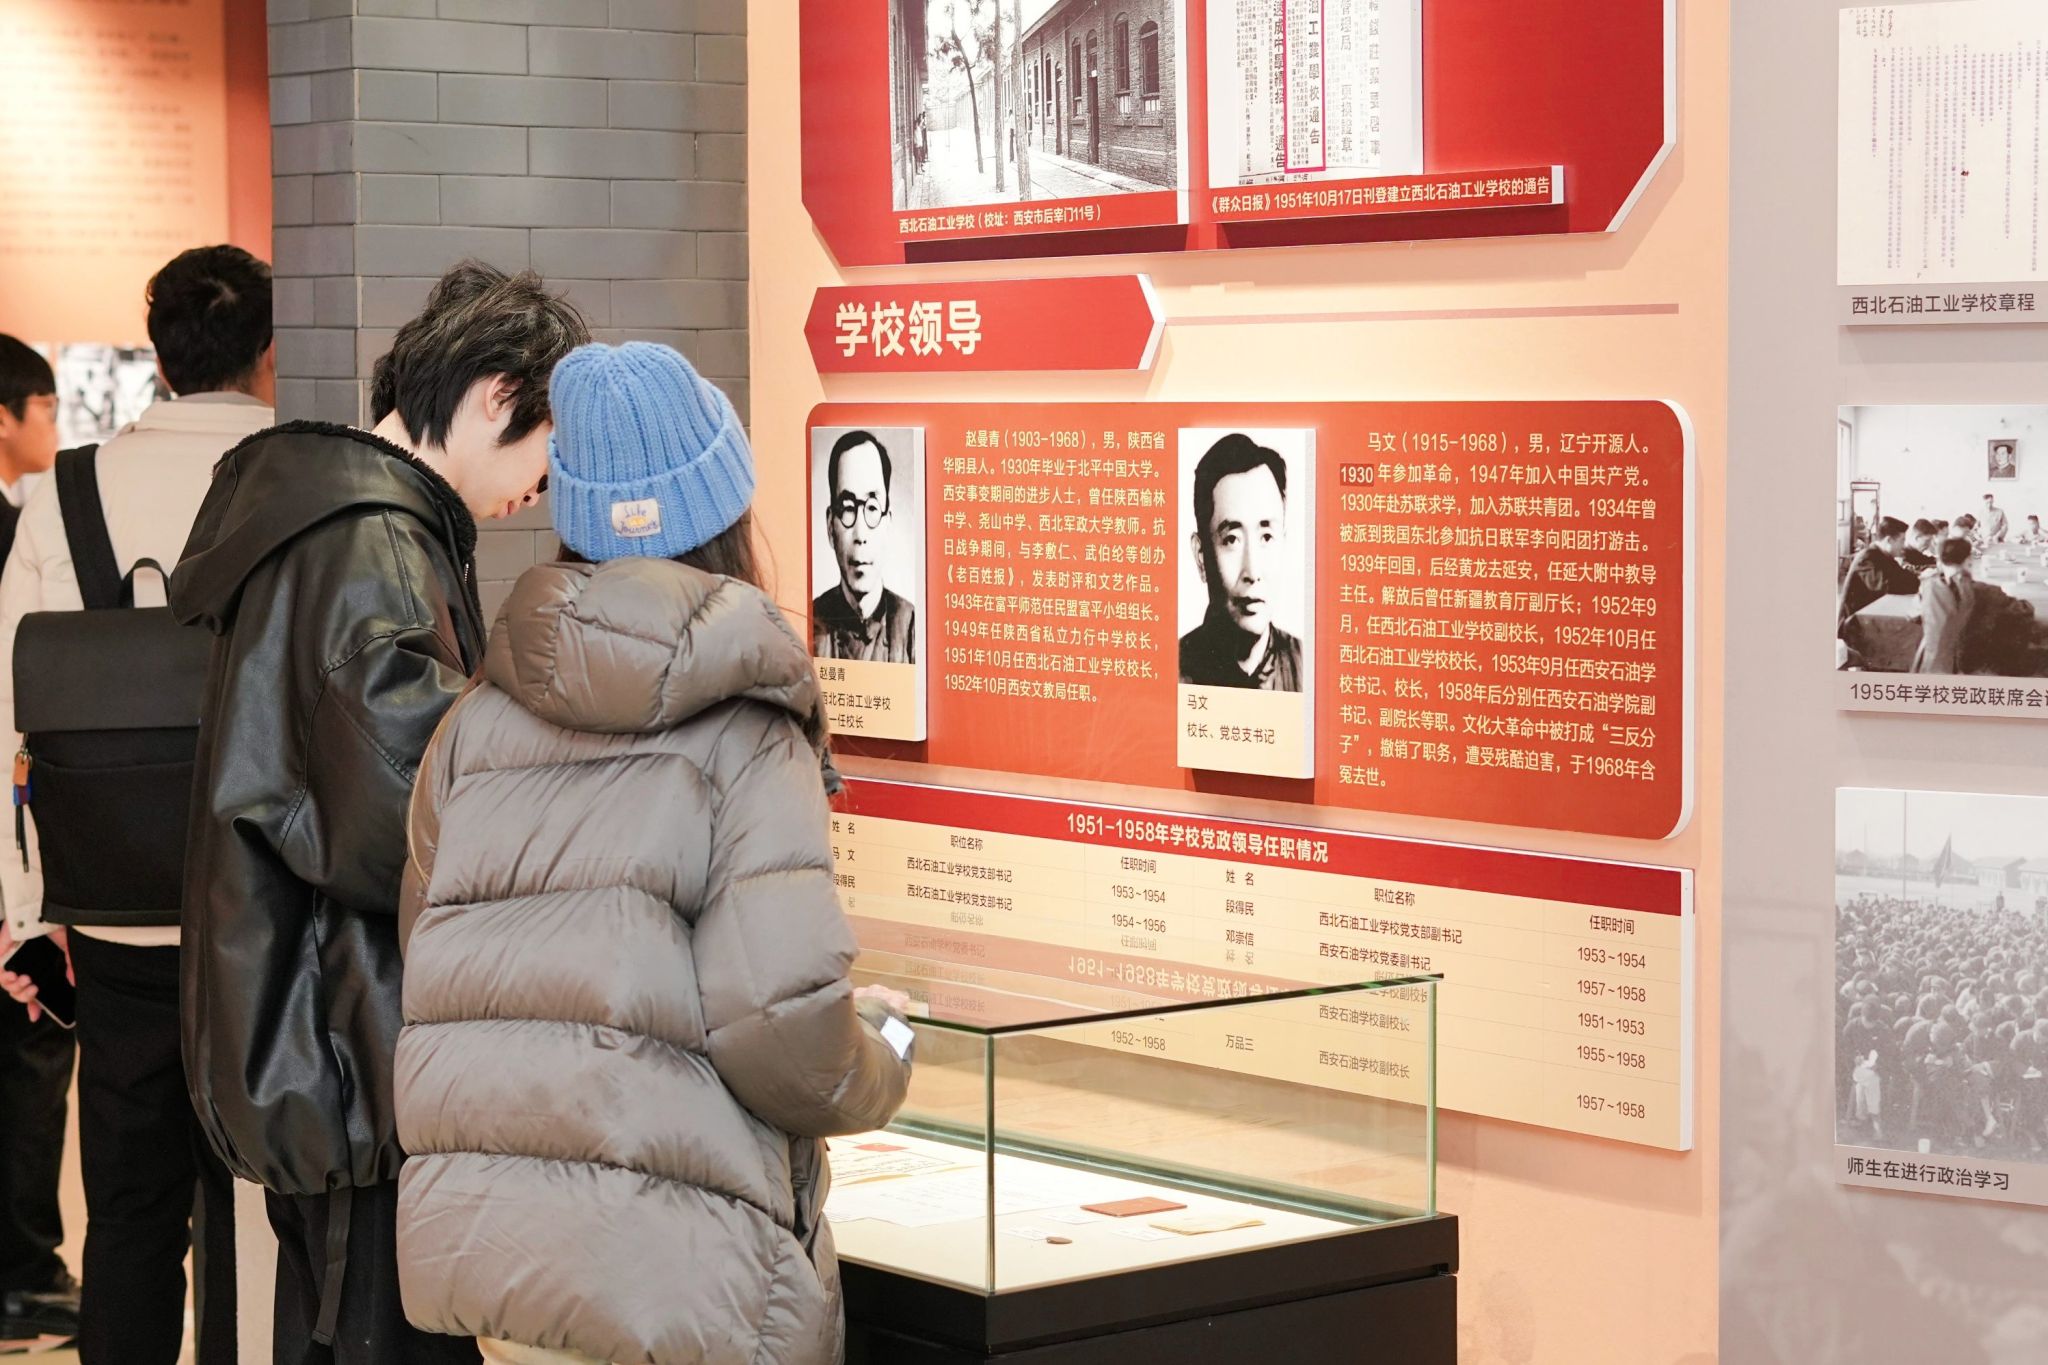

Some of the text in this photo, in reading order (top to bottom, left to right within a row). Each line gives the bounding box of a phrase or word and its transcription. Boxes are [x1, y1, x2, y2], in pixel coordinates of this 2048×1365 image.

[1851, 293, 2035, 315] 西北石油工业学校章程
[835, 299, 982, 357] 学校领导
[943, 456, 1161, 479] 华阴县人。1930年毕业于北平中国大学。
[943, 484, 1166, 508] 西安事变期间的进步人士，曾任陕西榆林
[1340, 493, 1657, 520] 1930年赴苏联求学，加入苏联共青团。1934年曾
[943, 511, 1166, 537] 中学、尧山中学、西北军政大学教师。抗
[1340, 523, 1650, 552] 被派到我国东北参加抗日联军李向阳团打游击。
[947, 564, 1160, 593] 《老百姓报》，发表时评和文艺作品。
[1340, 554, 1657, 586] 1939年回国，后经黄龙去延安，任延大附中教导
[944, 592, 1160, 622] 1943年在富平师范任民盟富平小组组长。
[1340, 584, 1657, 617] 主任。解放后曾任新疆教育厅副厅长；1952年9
[944, 620, 1159, 651] 1949年任陕西省私立力行中学校长，
[1340, 614, 1657, 651] 月，任西北石油工业学校副校长，1952年10月任
[819, 666, 846, 682] 赵曼青
[944, 647, 1159, 680] 1951年10月任西北石油工业学校校长，
[1340, 644, 1657, 683] 西北石油工业学校校长，1953年9月任西安石油学
[944, 674, 1098, 703] 1952年10月西安文教局任职。
[1340, 674, 1656, 716] 校书记、校长，1958年后分别任西安石油学院副
[1849, 683, 2048, 708] 1955年学校党政联席会
[1187, 694, 1209, 710] 马文
[827, 713, 864, 729] 一任校长
[1187, 722, 1275, 745] 校长、党总支书记
[1338, 765, 1387, 788] 冤去世。
[950, 834, 984, 852] 职位名称
[1066, 812, 1329, 864] 1951-1958年学校党政领导任职情况
[906, 856, 1013, 884] 西北石油工业学校党支部书记
[1120, 855, 1157, 874] 任职时间
[906, 884, 1013, 912] 西北石油工业学校党支部书记
[1111, 884, 1166, 904] 1953~1954
[1374, 887, 1416, 907] 职位名称
[1225, 898, 1255, 917] 段得民
[1111, 913, 1166, 933] 1954~1956
[1319, 911, 1463, 945] 西北石油工业学校党支部副书记
[1589, 914, 1635, 935] 任职时间
[1225, 928, 1255, 947] 邓崇信
[1319, 942, 1431, 972] 西安石油学校党委副书记
[1577, 946, 1646, 969] 1953~1954
[1577, 979, 1646, 1003] 1957~1958
[1319, 1004, 1410, 1033] 西安石油学校副校长
[1578, 1012, 1645, 1036] 1951~1953
[1111, 1030, 1166, 1051] 1952~1958
[1225, 1034, 1255, 1052] 万品三
[1319, 1050, 1410, 1080] 西安石油学校副校长
[1577, 1045, 1646, 1069] 1955~1958
[1576, 1094, 1646, 1119] 1957~1958
[1847, 1156, 2010, 1191] 师生在进行政治学习
